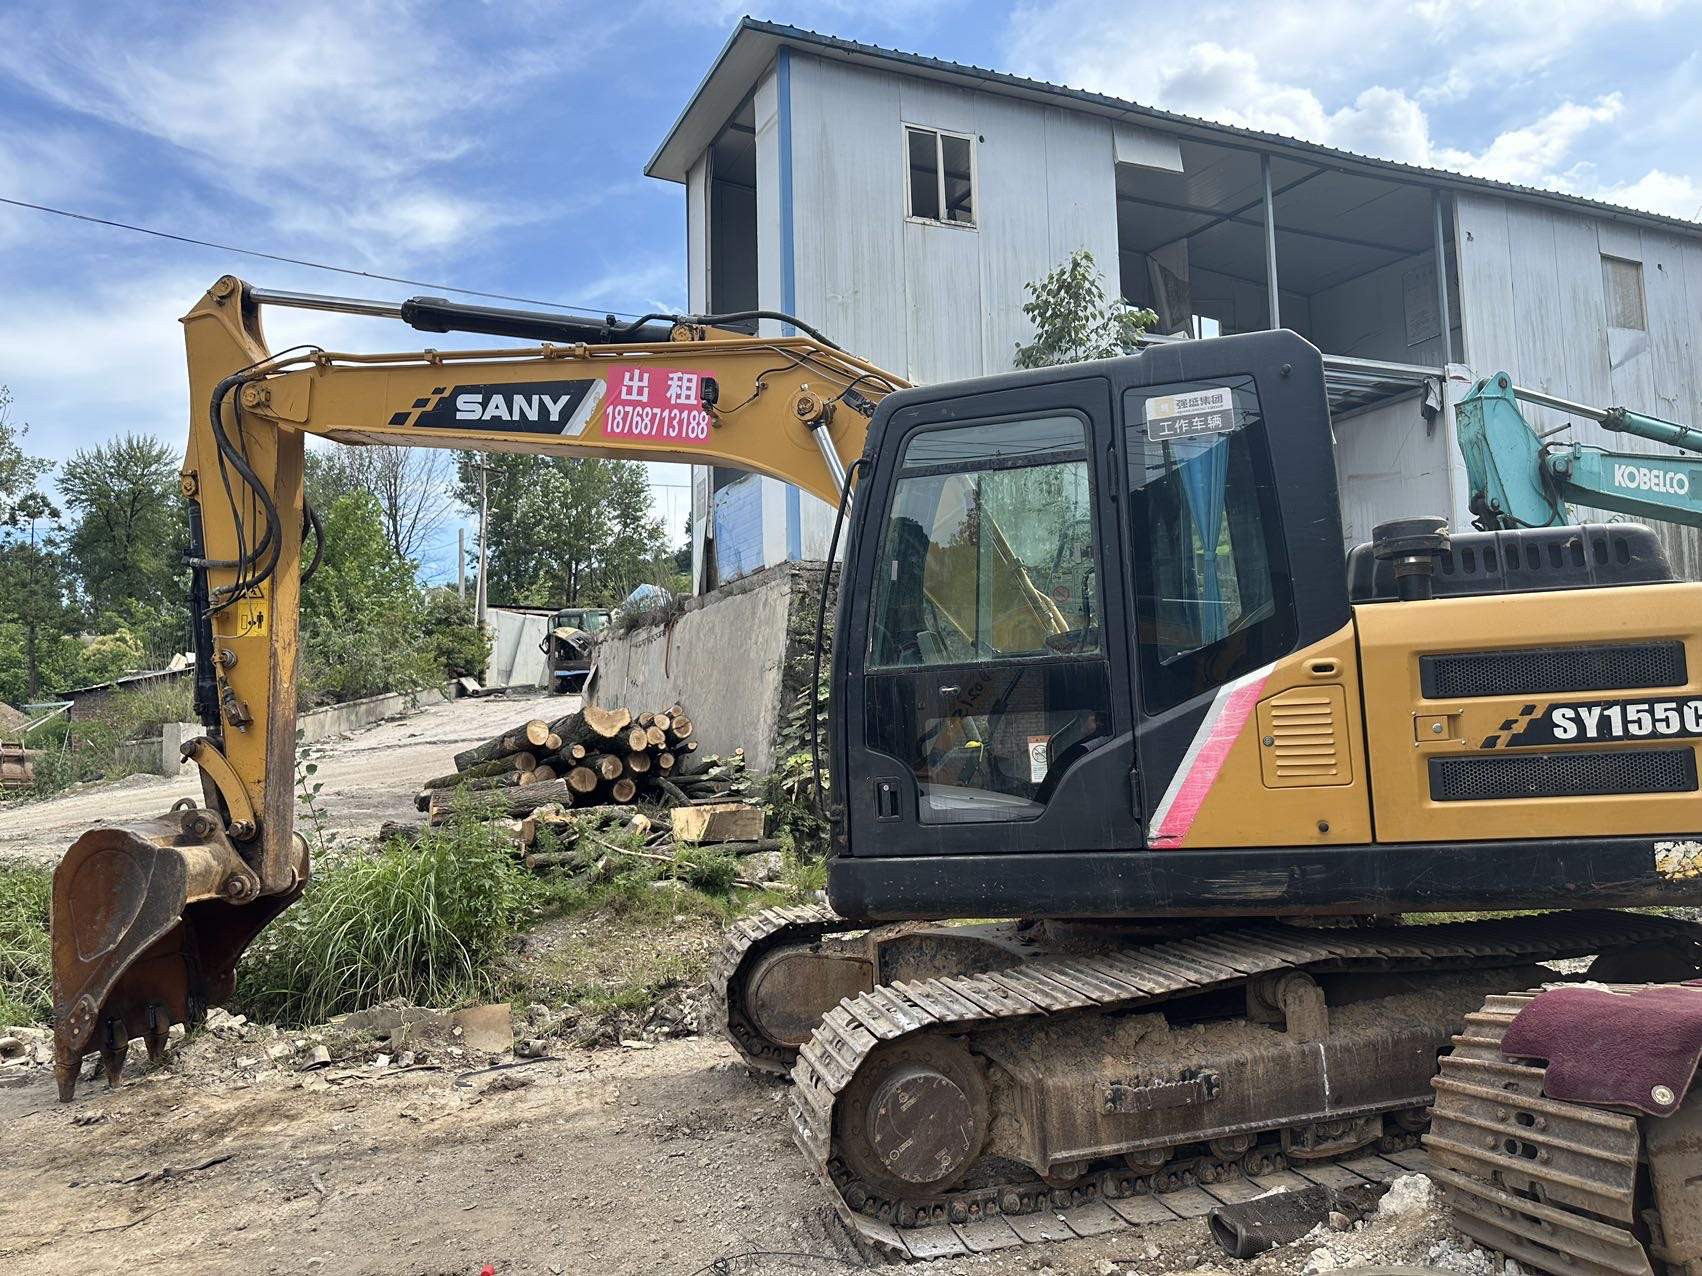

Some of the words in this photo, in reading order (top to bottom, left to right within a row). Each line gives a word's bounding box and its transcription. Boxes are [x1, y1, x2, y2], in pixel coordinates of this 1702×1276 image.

[455, 394, 571, 421] SANY
[606, 405, 709, 439] 18768713188
[1159, 414, 1222, 435] 工作车辆
[1614, 463, 1689, 495] KOBELCO
